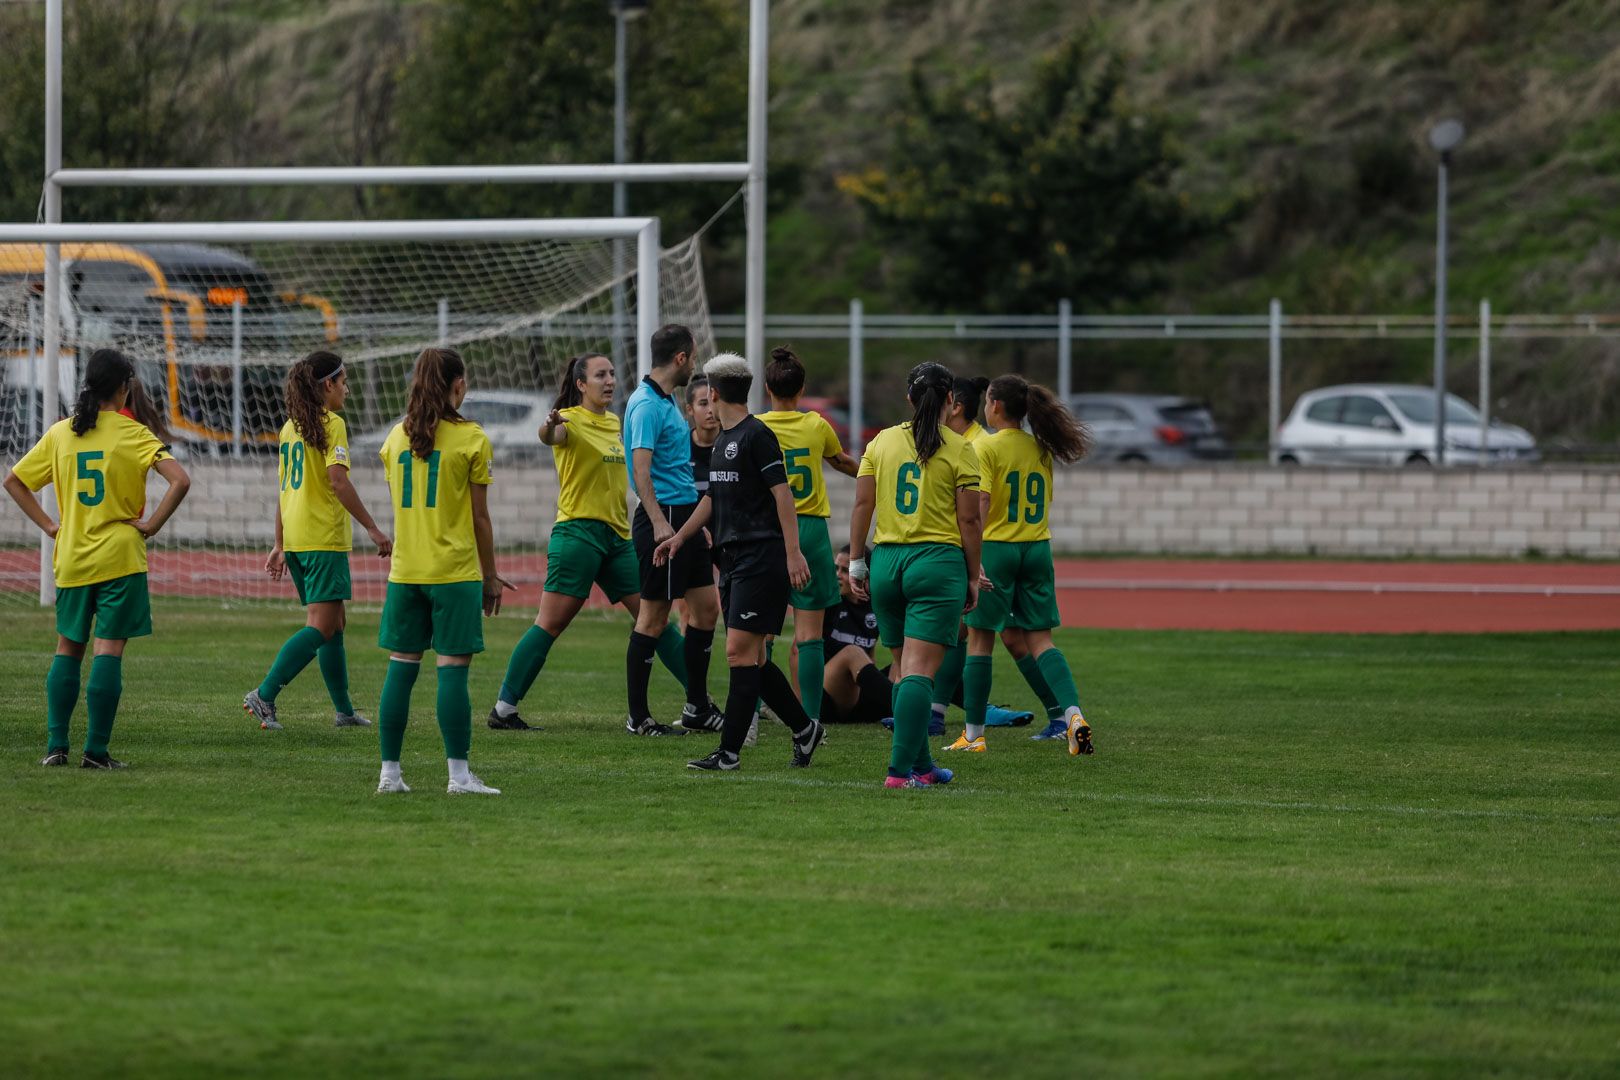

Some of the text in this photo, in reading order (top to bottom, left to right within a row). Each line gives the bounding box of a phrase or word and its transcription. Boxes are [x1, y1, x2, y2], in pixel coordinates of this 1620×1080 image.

[77, 451, 104, 506] 5
[280, 441, 304, 491] 18
[398, 450, 441, 508] 11
[895, 462, 921, 515] 6
[1006, 471, 1046, 524] 19
